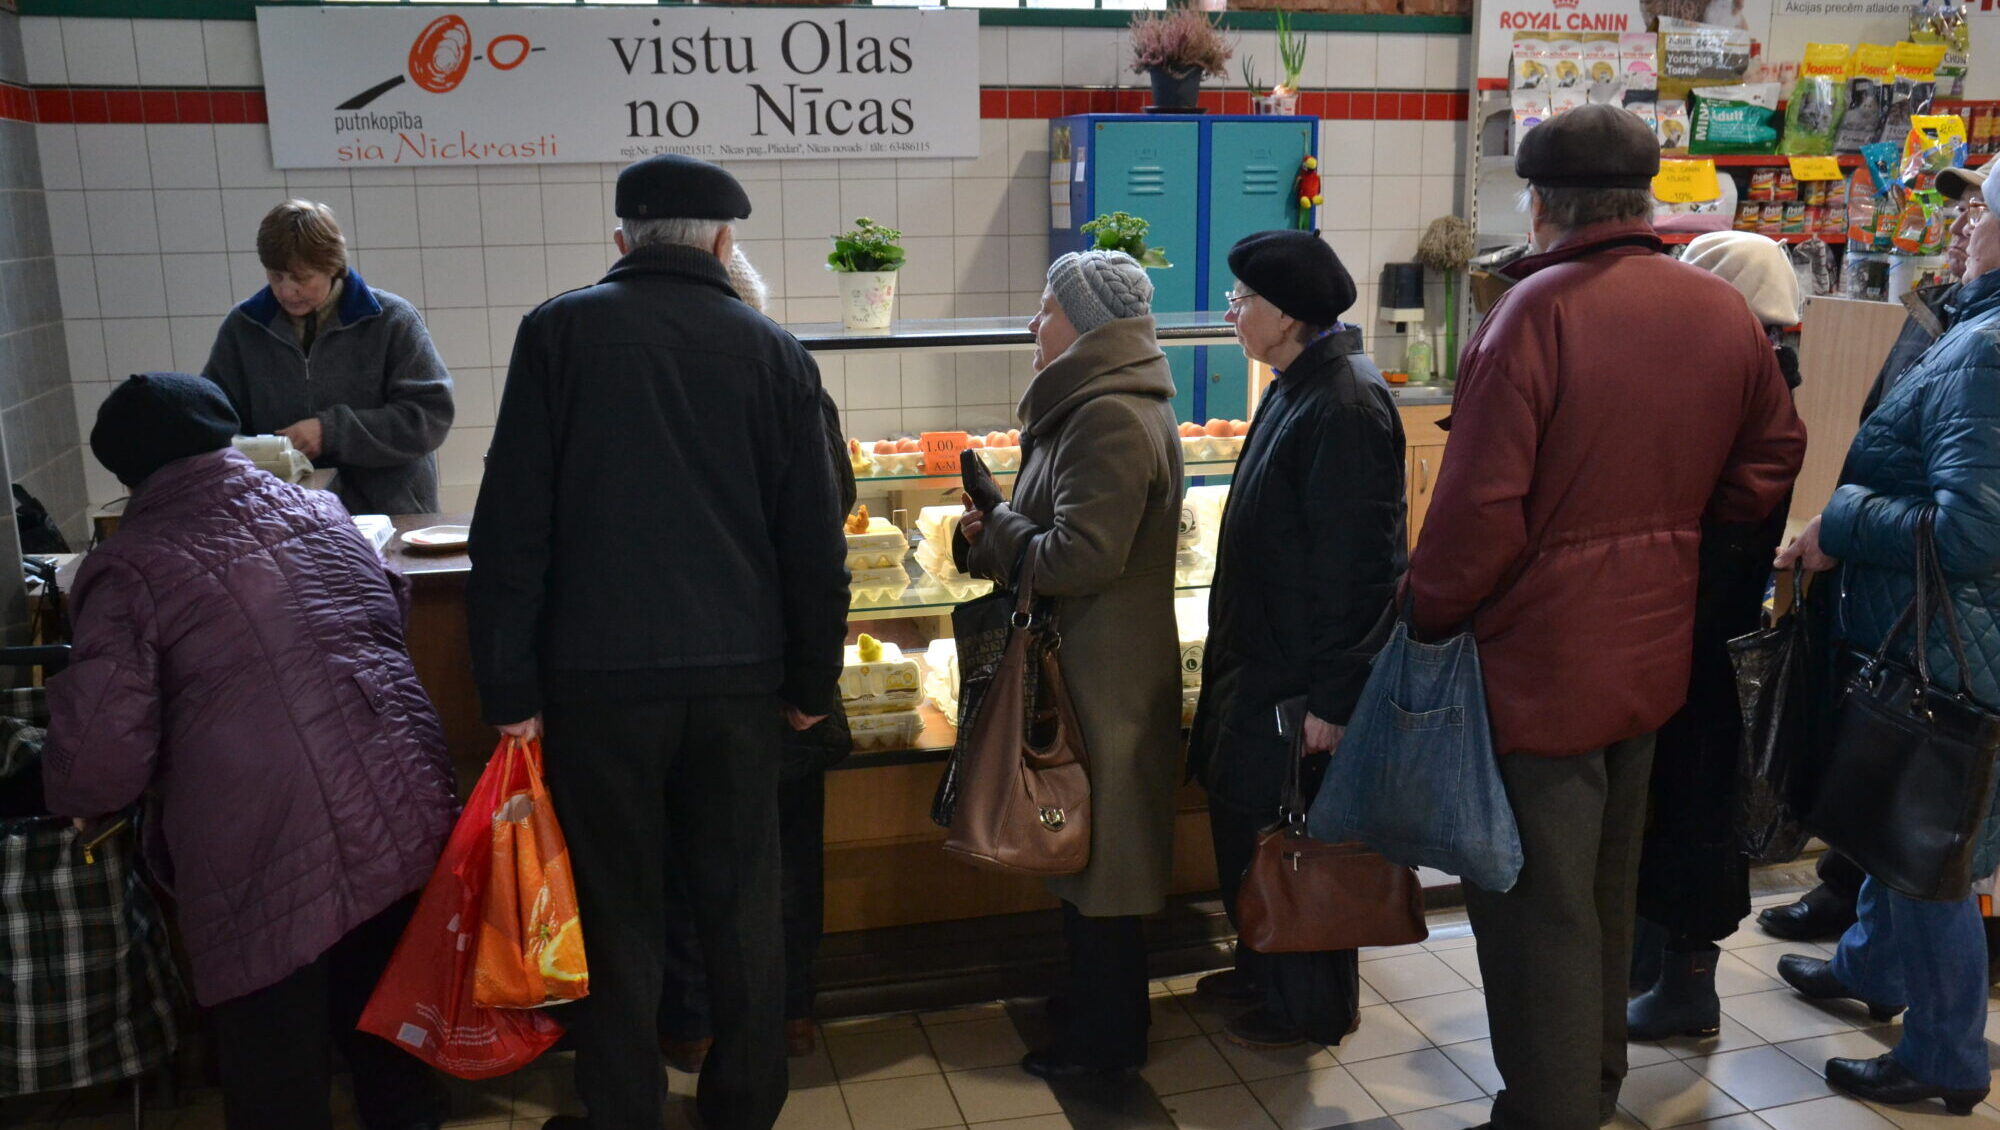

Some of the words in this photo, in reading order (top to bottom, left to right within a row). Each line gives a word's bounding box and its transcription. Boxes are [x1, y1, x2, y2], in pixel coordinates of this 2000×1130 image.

[1786, 1, 1822, 14] Akcijas
[1866, 3, 1899, 13] atlaide
[1500, 12, 1560, 30] ROYAL
[1566, 13, 1628, 31] CANIN
[608, 18, 758, 76] vistu
[780, 18, 914, 75] Olas
[624, 98, 700, 138] no
[746, 83, 915, 137] Nīcas
[334, 110, 423, 135] putnkopība
[337, 137, 385, 163] sia
[393, 130, 559, 164] Nickrasti
[888, 141, 930, 153] 63486115
[926, 439, 954, 452] 1.00
[1188, 660, 1195, 669] L
